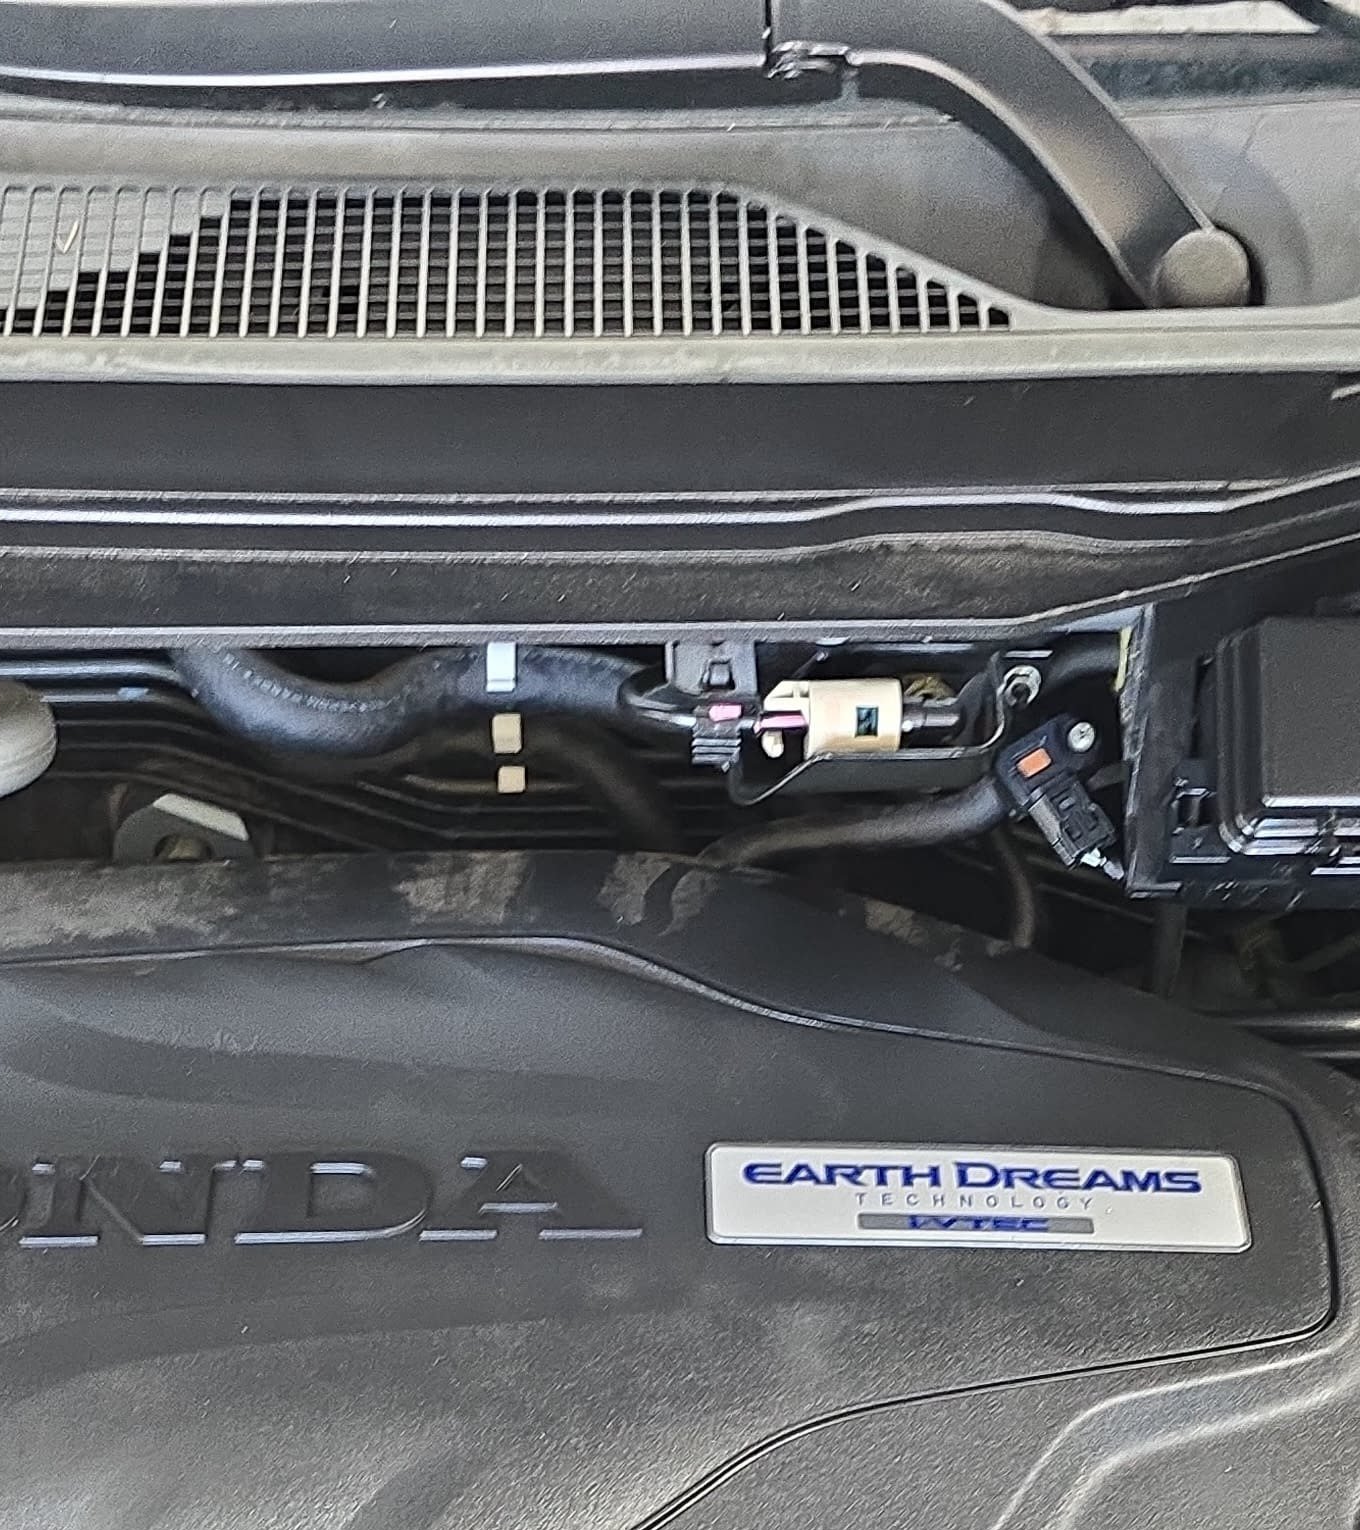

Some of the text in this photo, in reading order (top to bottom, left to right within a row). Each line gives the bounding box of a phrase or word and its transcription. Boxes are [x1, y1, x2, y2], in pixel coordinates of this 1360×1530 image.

[744, 1162, 1203, 1193] EARTH DREAMS
[855, 1193, 1094, 1210] TECHNOLOGY
